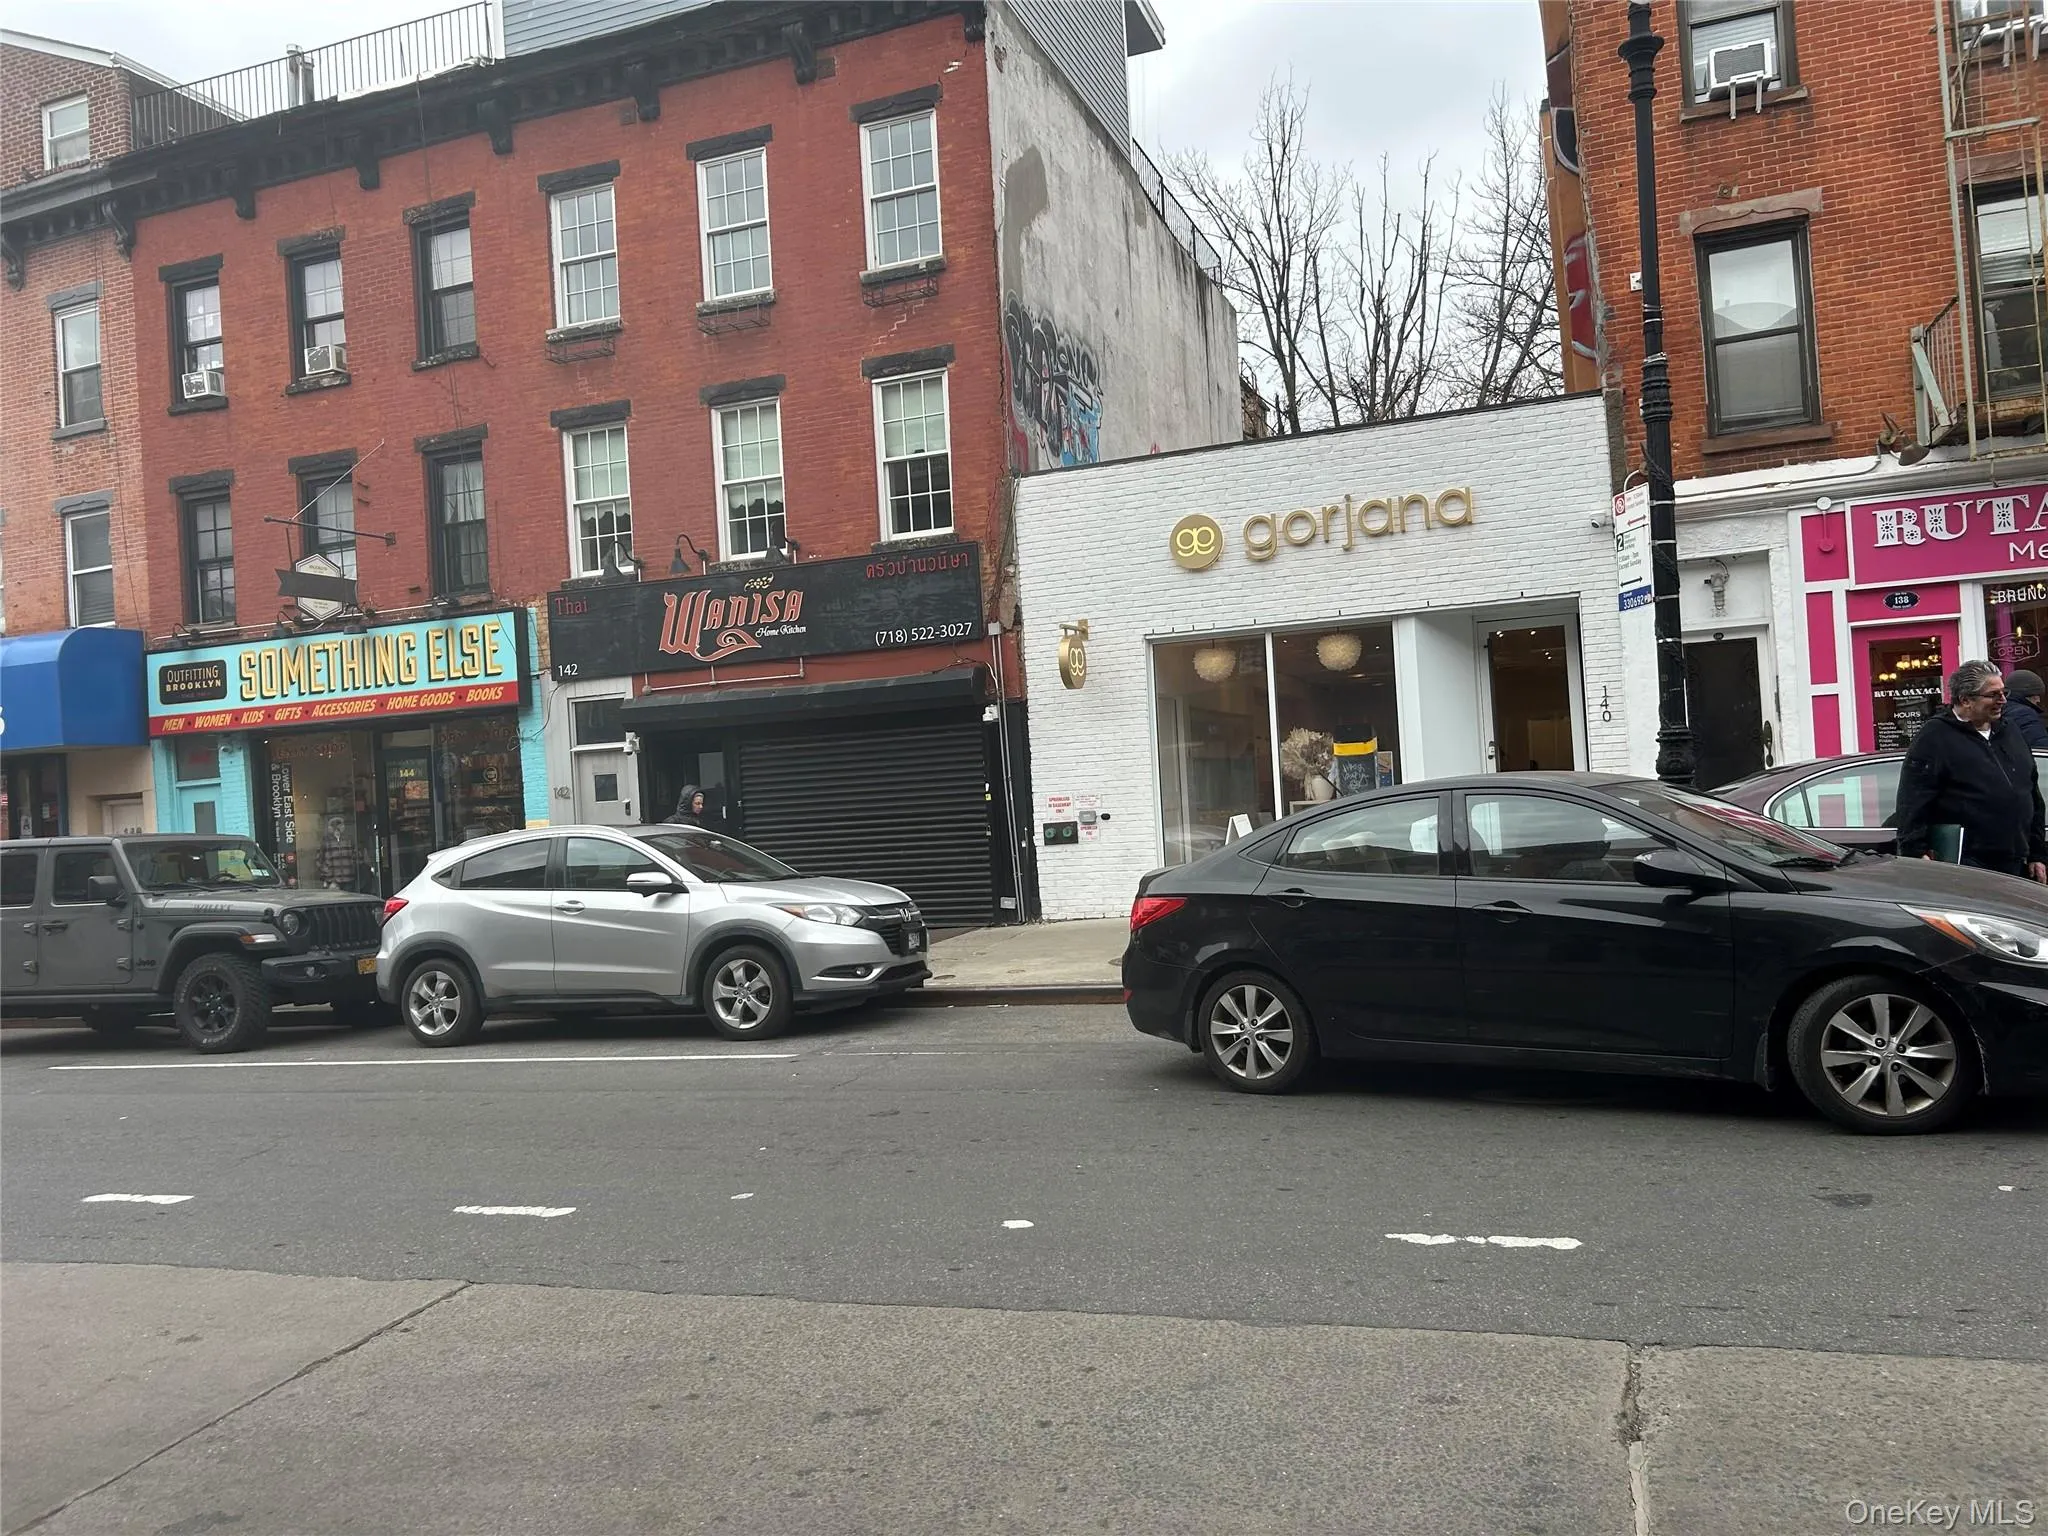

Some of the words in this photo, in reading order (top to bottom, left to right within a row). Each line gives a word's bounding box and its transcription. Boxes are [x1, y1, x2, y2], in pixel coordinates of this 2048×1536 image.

[1243, 486, 1473, 561] gorjana
[554, 596, 588, 617] Thai
[1894, 596, 1910, 605] 138
[755, 626, 779, 638] Home
[779, 624, 807, 636] Kitchen
[874, 629, 908, 647] (718)
[911, 622, 973, 642] 522-3027
[239, 631, 417, 701] SOMETHING
[427, 621, 504, 683] ELSE
[1998, 645, 2030, 657] OPEN
[167, 664, 219, 683] OUTFITTING
[558, 663, 579, 677] 142
[165, 679, 221, 692] BROOKLYN
[1873, 689, 1900, 698] RUTA
[1902, 687, 1942, 696] OAXACA
[162, 717, 185, 732] MEN
[194, 713, 232, 729] WOMEN
[240, 709, 265, 725] KIDS
[274, 706, 303, 721] GIFTS
[311, 698, 377, 718] ACCESSORIES
[386, 694, 419, 711] HOME
[420, 691, 456, 707] GOODS
[466, 686, 504, 703] BOOKS
[1600, 685, 1612, 723] 140
[1893, 711, 1921, 719] HOURS
[281, 763, 291, 793] Lower
[399, 768, 415, 777] 144
[271, 774, 282, 818] Brooklyn
[553, 785, 571, 800] 142
[283, 795, 294, 820] East
[285, 821, 296, 844] Side
